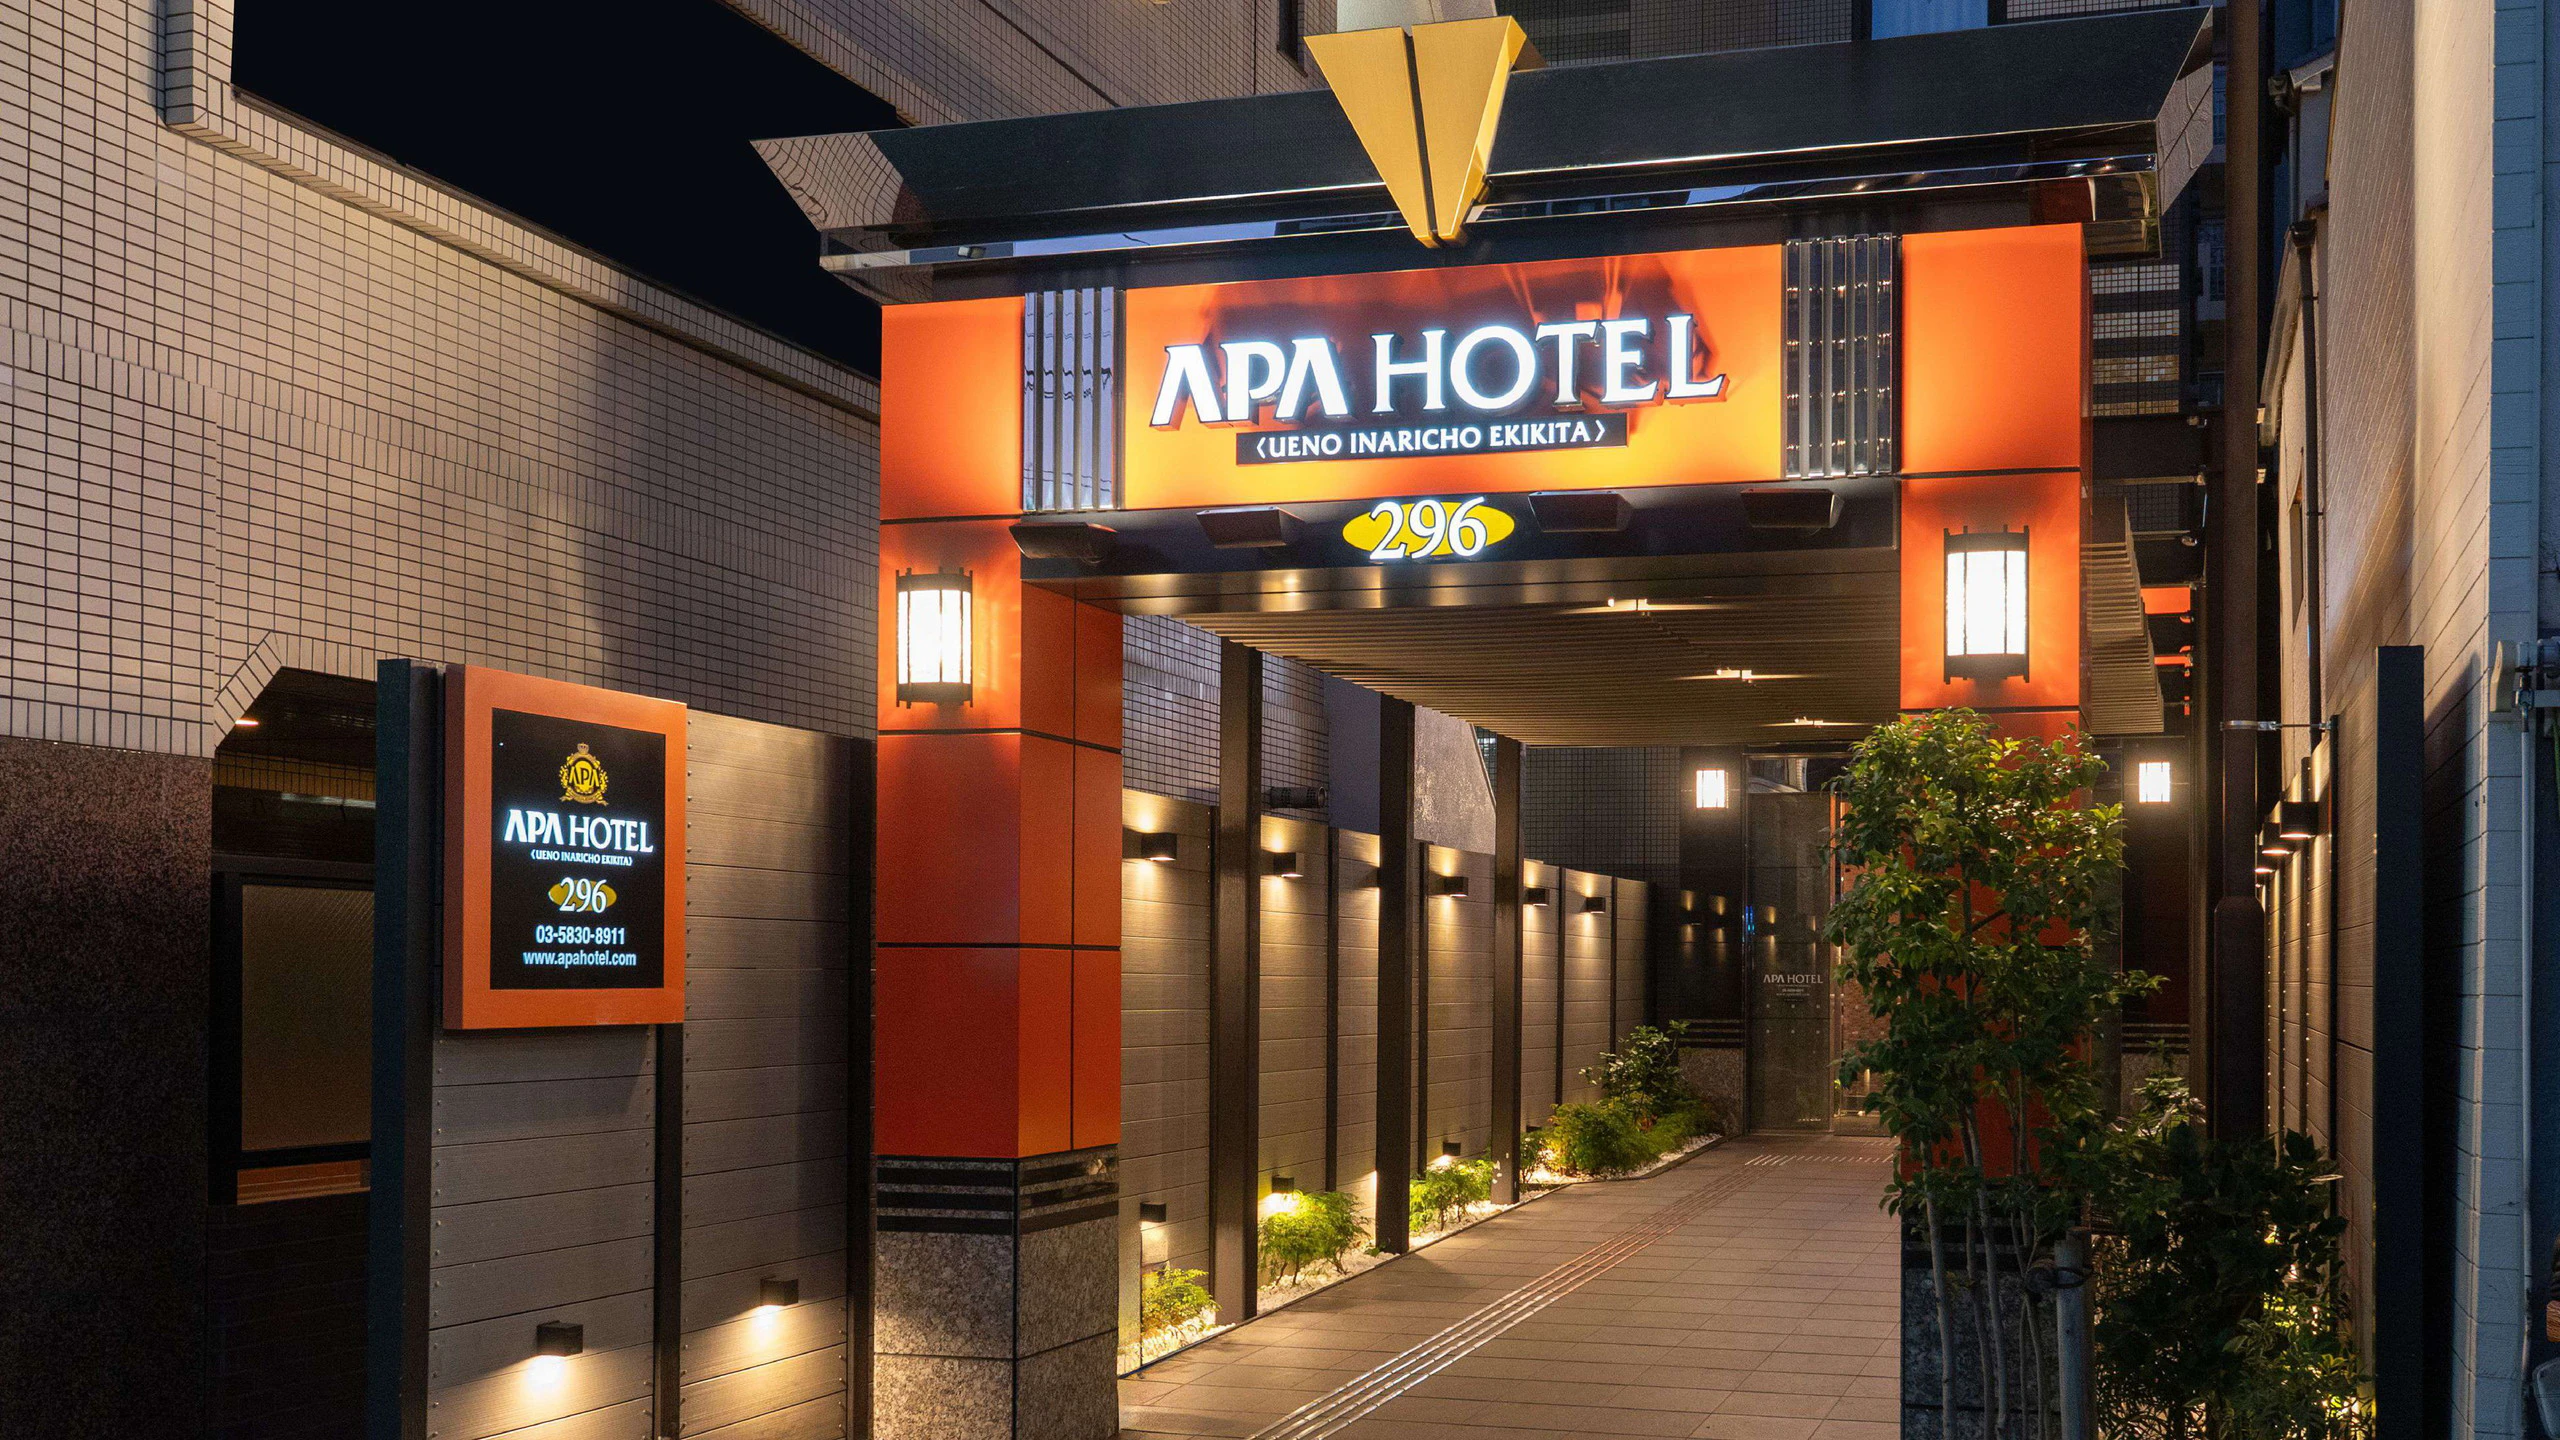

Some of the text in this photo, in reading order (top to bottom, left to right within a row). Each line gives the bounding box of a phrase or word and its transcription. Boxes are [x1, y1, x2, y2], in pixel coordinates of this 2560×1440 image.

[1149, 313, 1727, 428] APA HOTEL
[1349, 425, 1482, 456] INARICHO
[1367, 496, 1488, 561] 296
[568, 765, 600, 788] APA
[504, 808, 654, 853] APA HOTEL
[561, 851, 600, 864] INARICHO
[559, 877, 608, 914] 296
[536, 925, 626, 945] 03-5830-8911
[523, 950, 637, 969] www.apahotel.com
[1763, 974, 1824, 984] APA HOTEL
